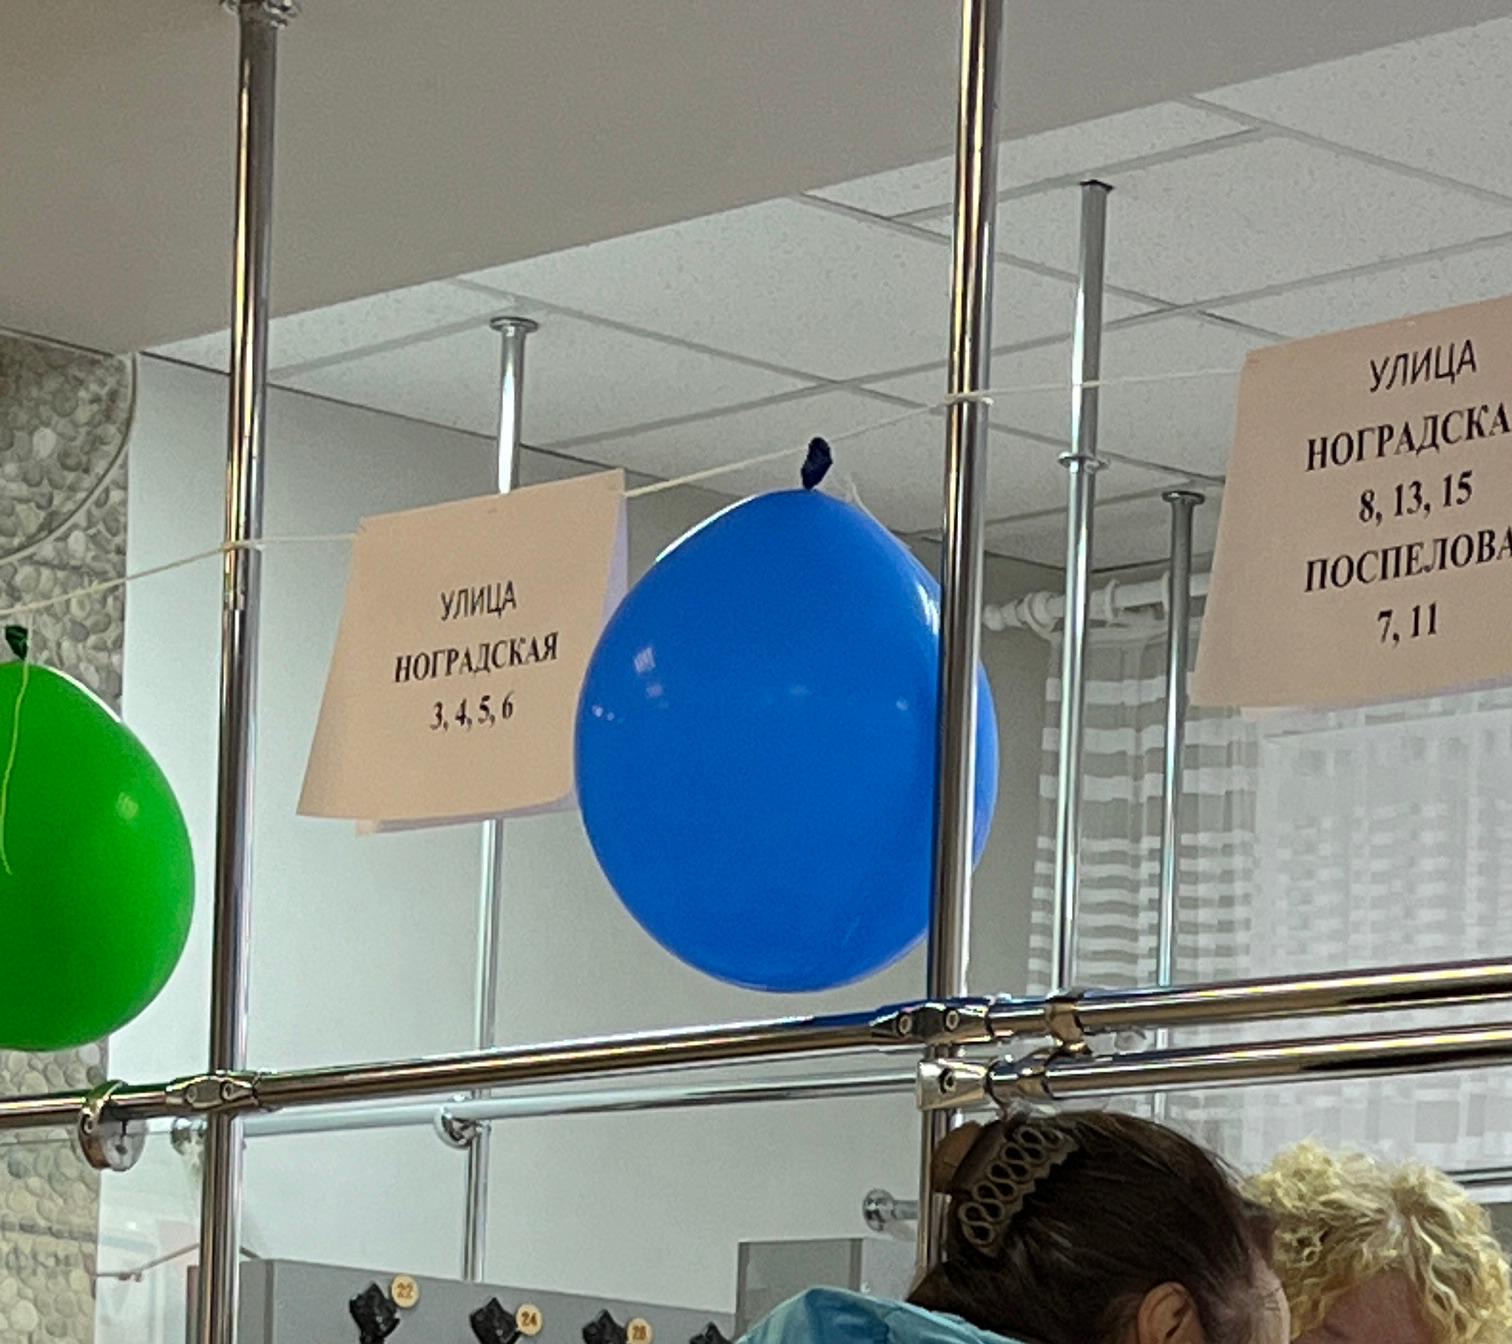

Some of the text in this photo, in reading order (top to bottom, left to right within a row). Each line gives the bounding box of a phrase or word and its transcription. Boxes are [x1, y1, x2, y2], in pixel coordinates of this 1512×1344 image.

[1369, 339, 1478, 393] УЛИЦА
[1358, 470, 1473, 527] 8, 13, 15
[440, 580, 517, 622] УЛИЦА
[1376, 603, 1438, 646] 7, 11
[394, 631, 560, 684] НОГРАДСКАЯ
[430, 691, 514, 732] 3, 4, 5, 6
